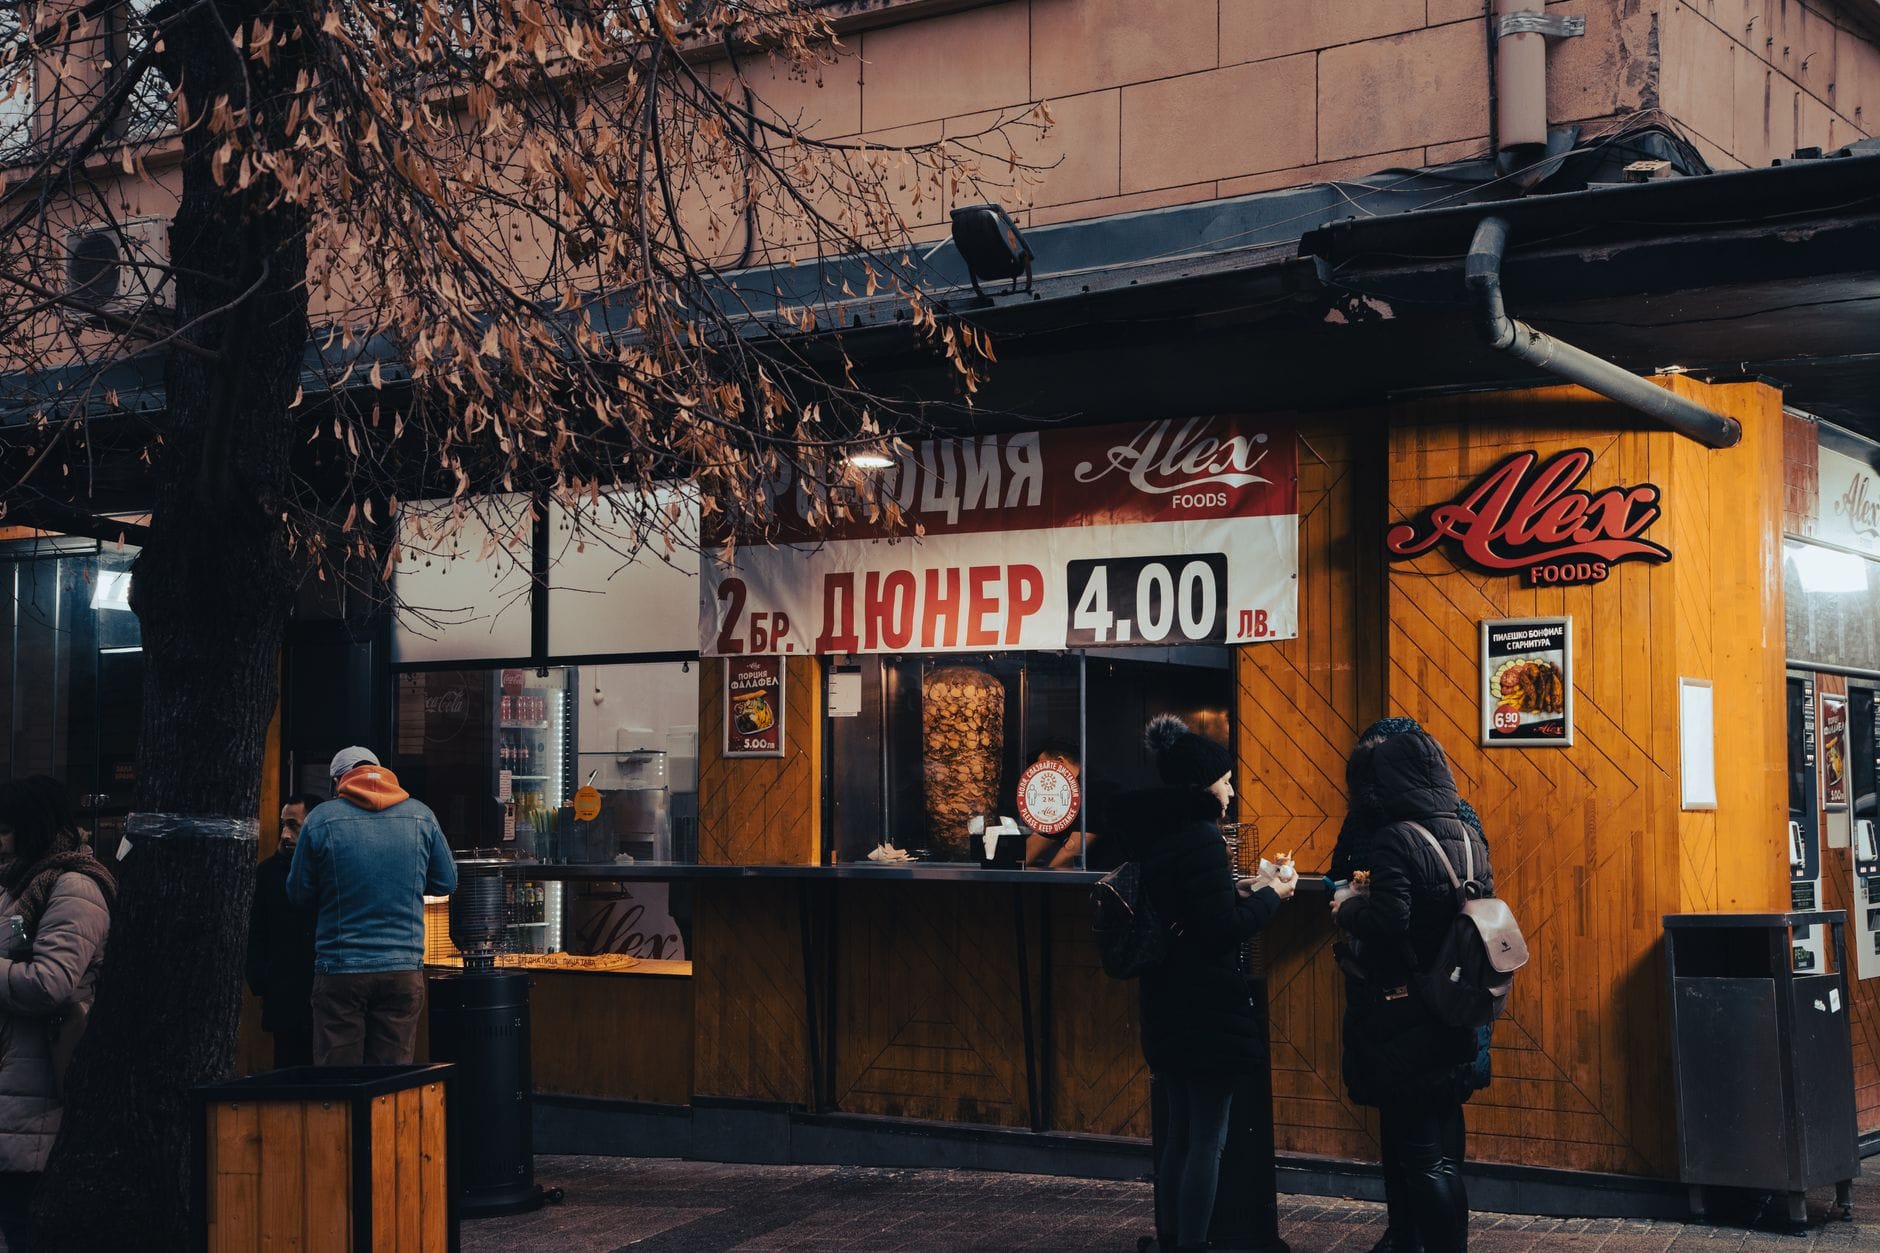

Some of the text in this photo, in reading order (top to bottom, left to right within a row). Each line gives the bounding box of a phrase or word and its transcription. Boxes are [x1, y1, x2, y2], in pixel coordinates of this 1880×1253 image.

[1074, 416, 1273, 494] Alex
[1172, 492, 1227, 508] FOODS
[1387, 449, 1672, 568] Alex
[1530, 561, 1607, 583] FOODS
[717, 560, 1277, 655] 2 БР. ДЮНЕР 4.00 ЛВ.
[1493, 627, 1563, 642] ПИЛЕШКО БОНФИЛЕ
[1512, 638, 1551, 650] ГАРНИТУРА
[730, 677, 779, 690] ФАЛАФЕЛ
[738, 670, 768, 680] ПОРЦИЯ
[1021, 808, 1038, 829] PLEASE
[1038, 824, 1053, 833] KEEP
[1054, 807, 1077, 832] DISTANCE
